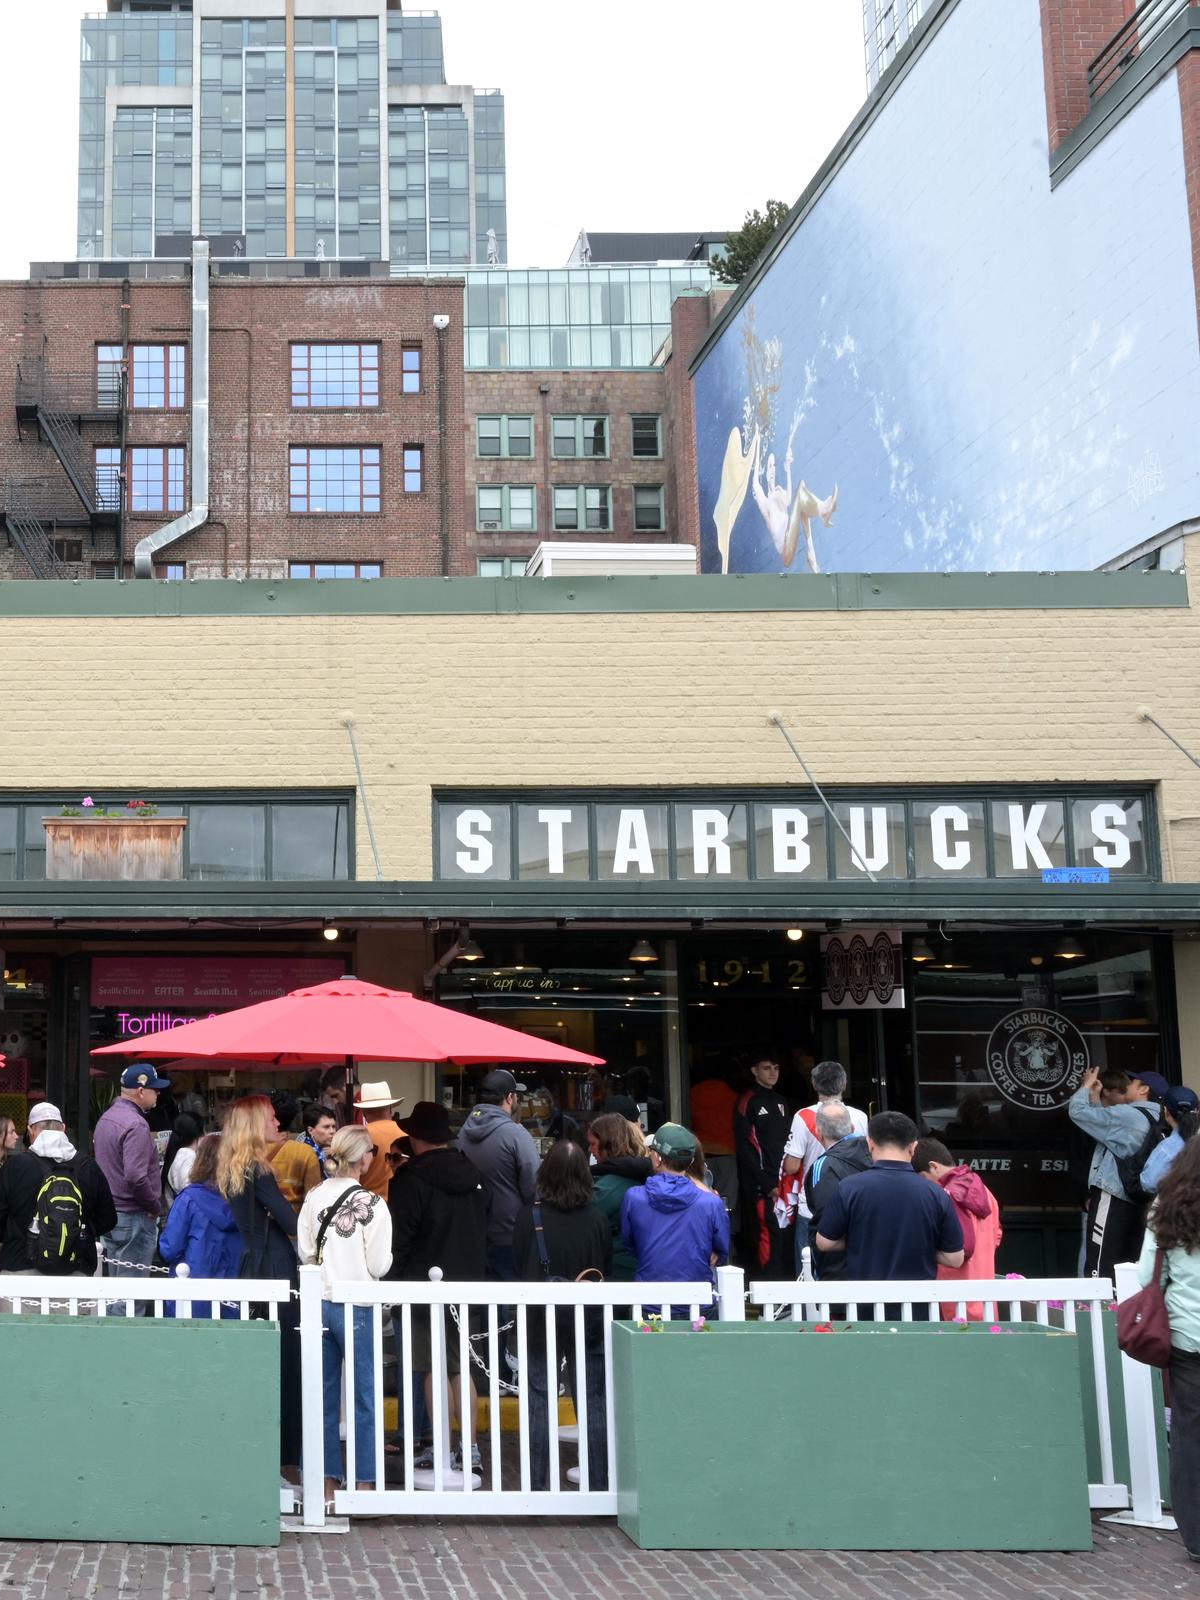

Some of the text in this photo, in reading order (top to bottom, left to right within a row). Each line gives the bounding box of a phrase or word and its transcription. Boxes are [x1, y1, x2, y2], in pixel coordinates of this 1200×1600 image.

[455, 803, 1127, 873] STARBUCKS
[696, 959, 807, 984] 1912
[1003, 1012, 1068, 1034] STARBUCKS
[990, 1051, 1019, 1095] COFFEE
[1065, 1052, 1085, 1090] SPICES
[1032, 1093, 1056, 1106] TEA
[958, 1158, 1012, 1171] LATTE
